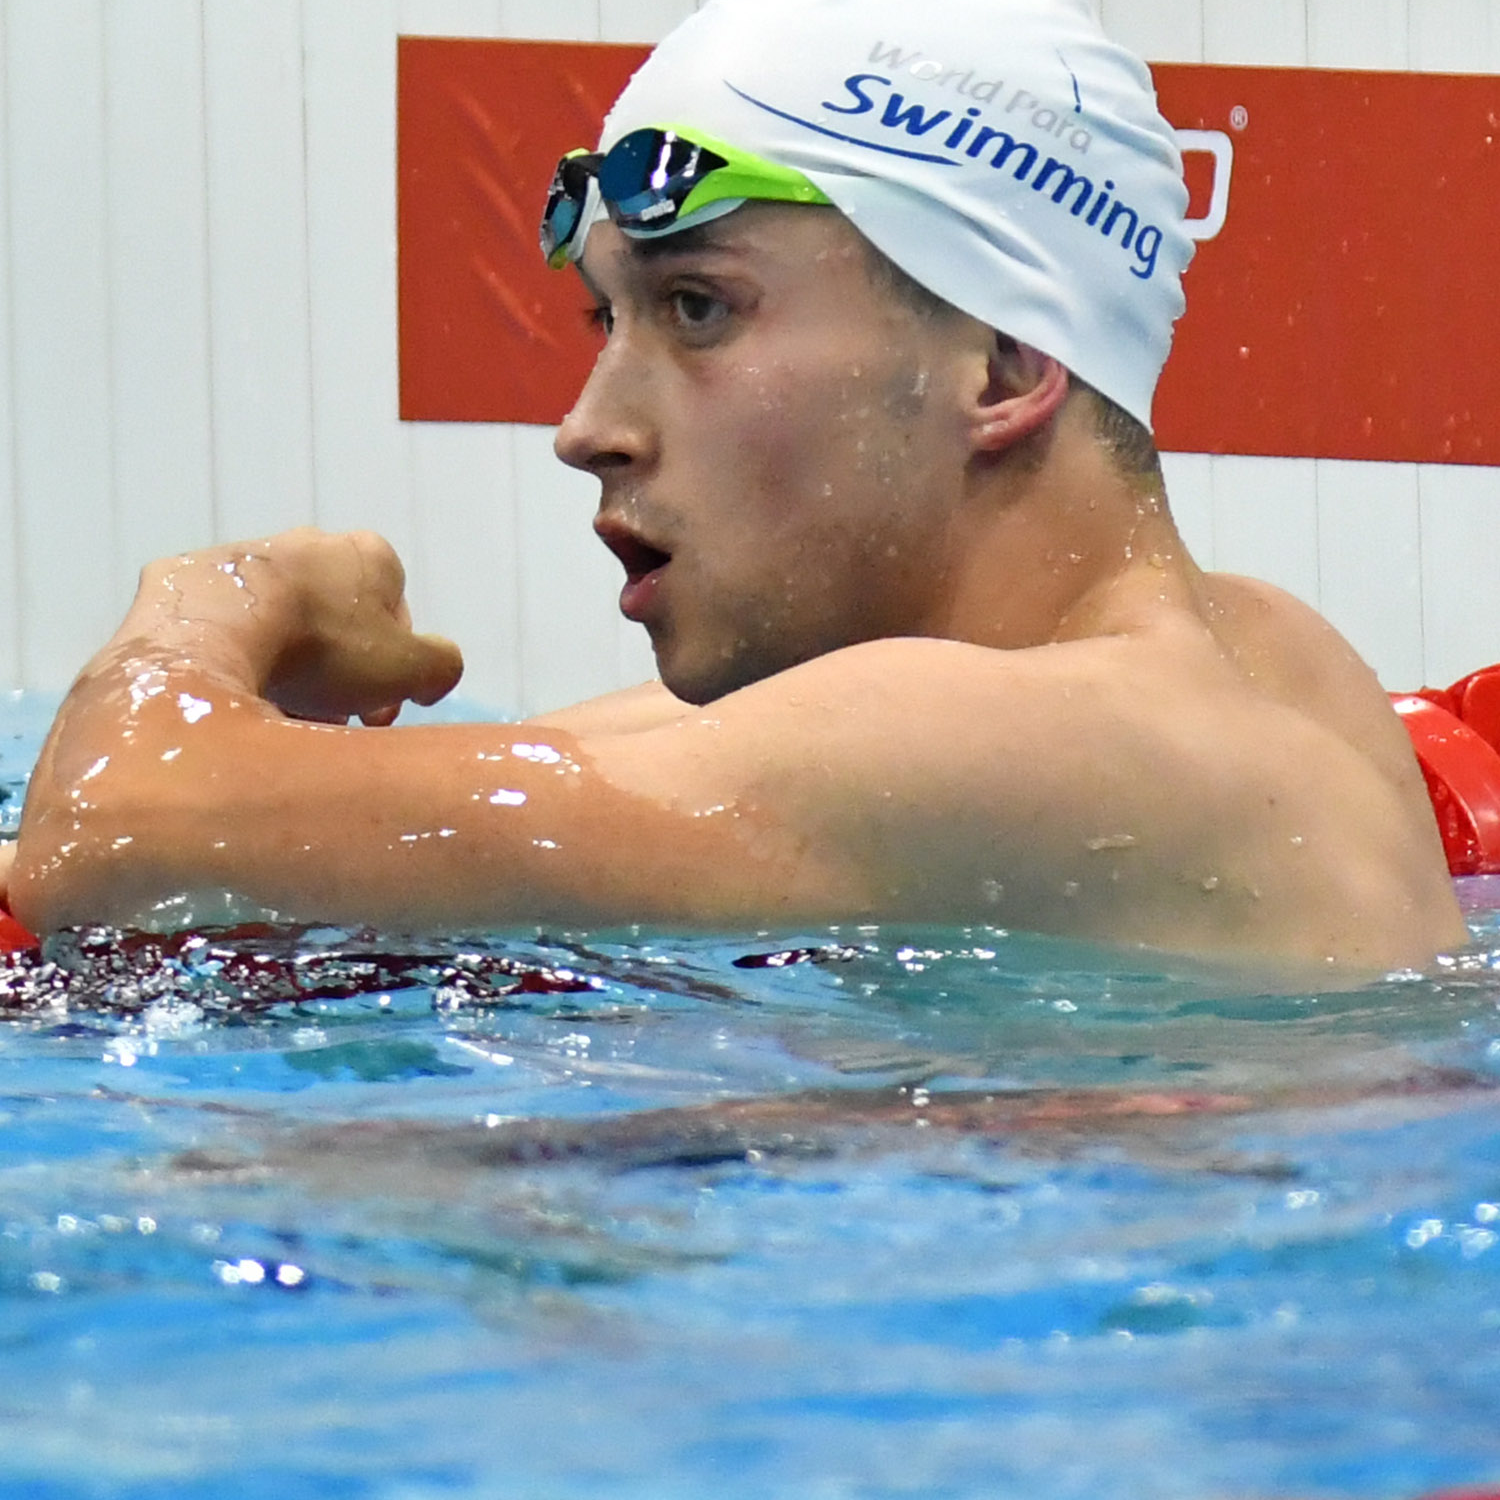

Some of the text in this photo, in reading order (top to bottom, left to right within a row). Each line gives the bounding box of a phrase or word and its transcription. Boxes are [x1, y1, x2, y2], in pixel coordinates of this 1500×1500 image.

[821, 73, 1163, 280] Swimming
[867, 40, 1094, 155] World Para
